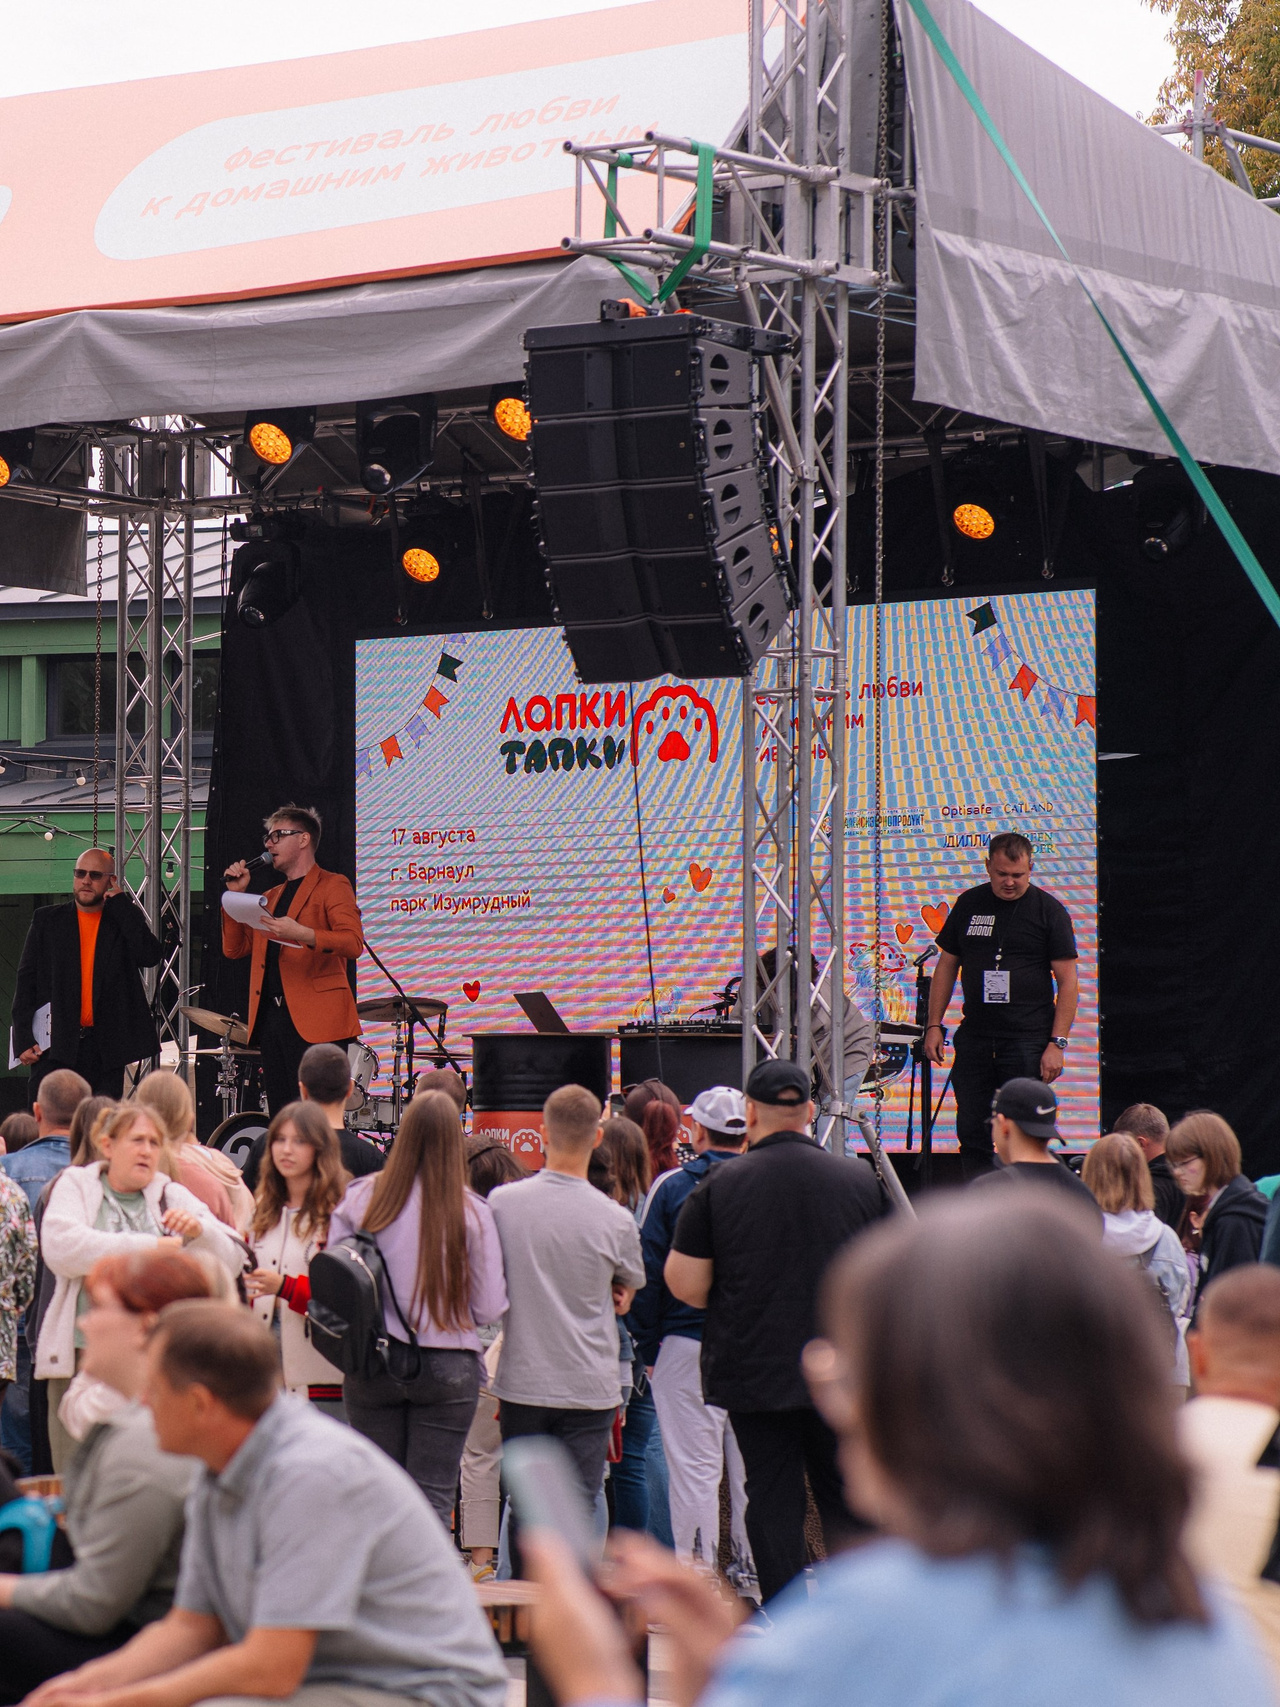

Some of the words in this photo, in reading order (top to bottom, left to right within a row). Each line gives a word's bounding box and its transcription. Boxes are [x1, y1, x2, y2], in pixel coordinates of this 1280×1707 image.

[470, 93, 623, 137] любви
[140, 193, 172, 218] к
[174, 159, 404, 221] домашним
[859, 676, 922, 699] любви
[500, 735, 626, 774] ТАПКИ
[941, 804, 993, 818] Optisafe
[1004, 802, 1054, 814] CATLAND
[390, 828, 406, 845] 17
[412, 828, 475, 848] августа
[390, 868, 402, 881] г.
[408, 862, 474, 885] Барнаул
[390, 895, 427, 914] парк
[432, 890, 531, 914] Изумрудный
[966, 925, 993, 937] ROOM
[970, 914, 996, 925] SOUND
